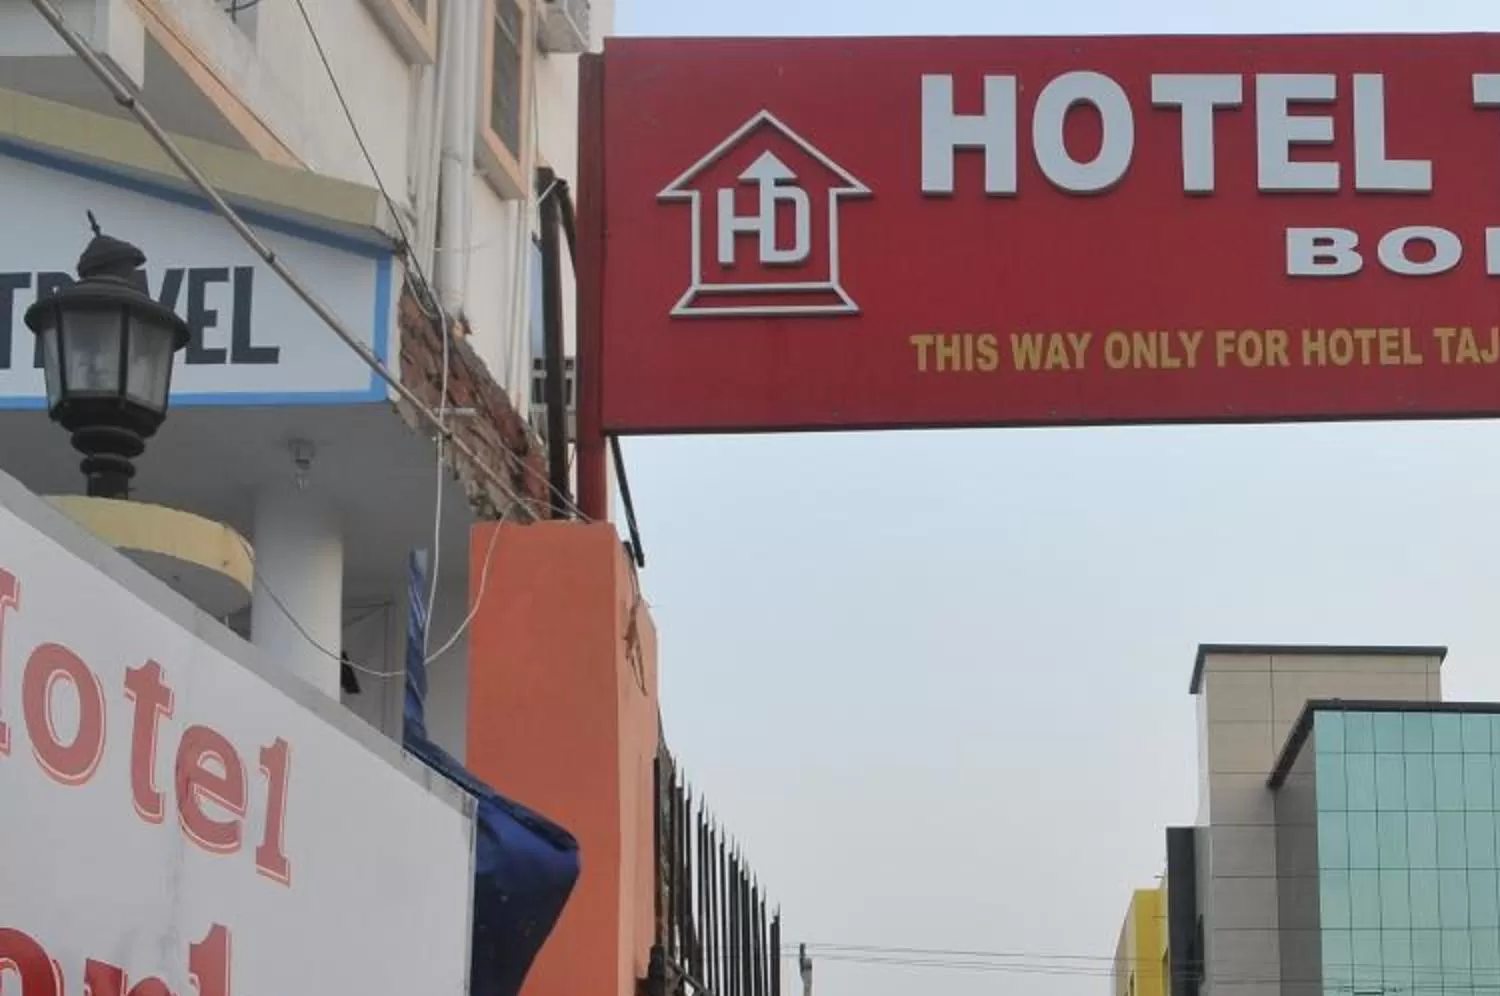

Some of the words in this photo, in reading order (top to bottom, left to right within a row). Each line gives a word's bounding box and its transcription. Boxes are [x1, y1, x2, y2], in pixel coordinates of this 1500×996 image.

[921, 70, 1433, 197] HOTEL
[0, 265, 280, 370] TEL
[909, 333, 999, 373] THIS
[1011, 332, 1093, 371] WAY
[1104, 330, 1203, 370] ONLY
[1215, 329, 1291, 368] FOR
[1301, 327, 1424, 367] HOTEL
[1433, 326, 1500, 364] TAJ
